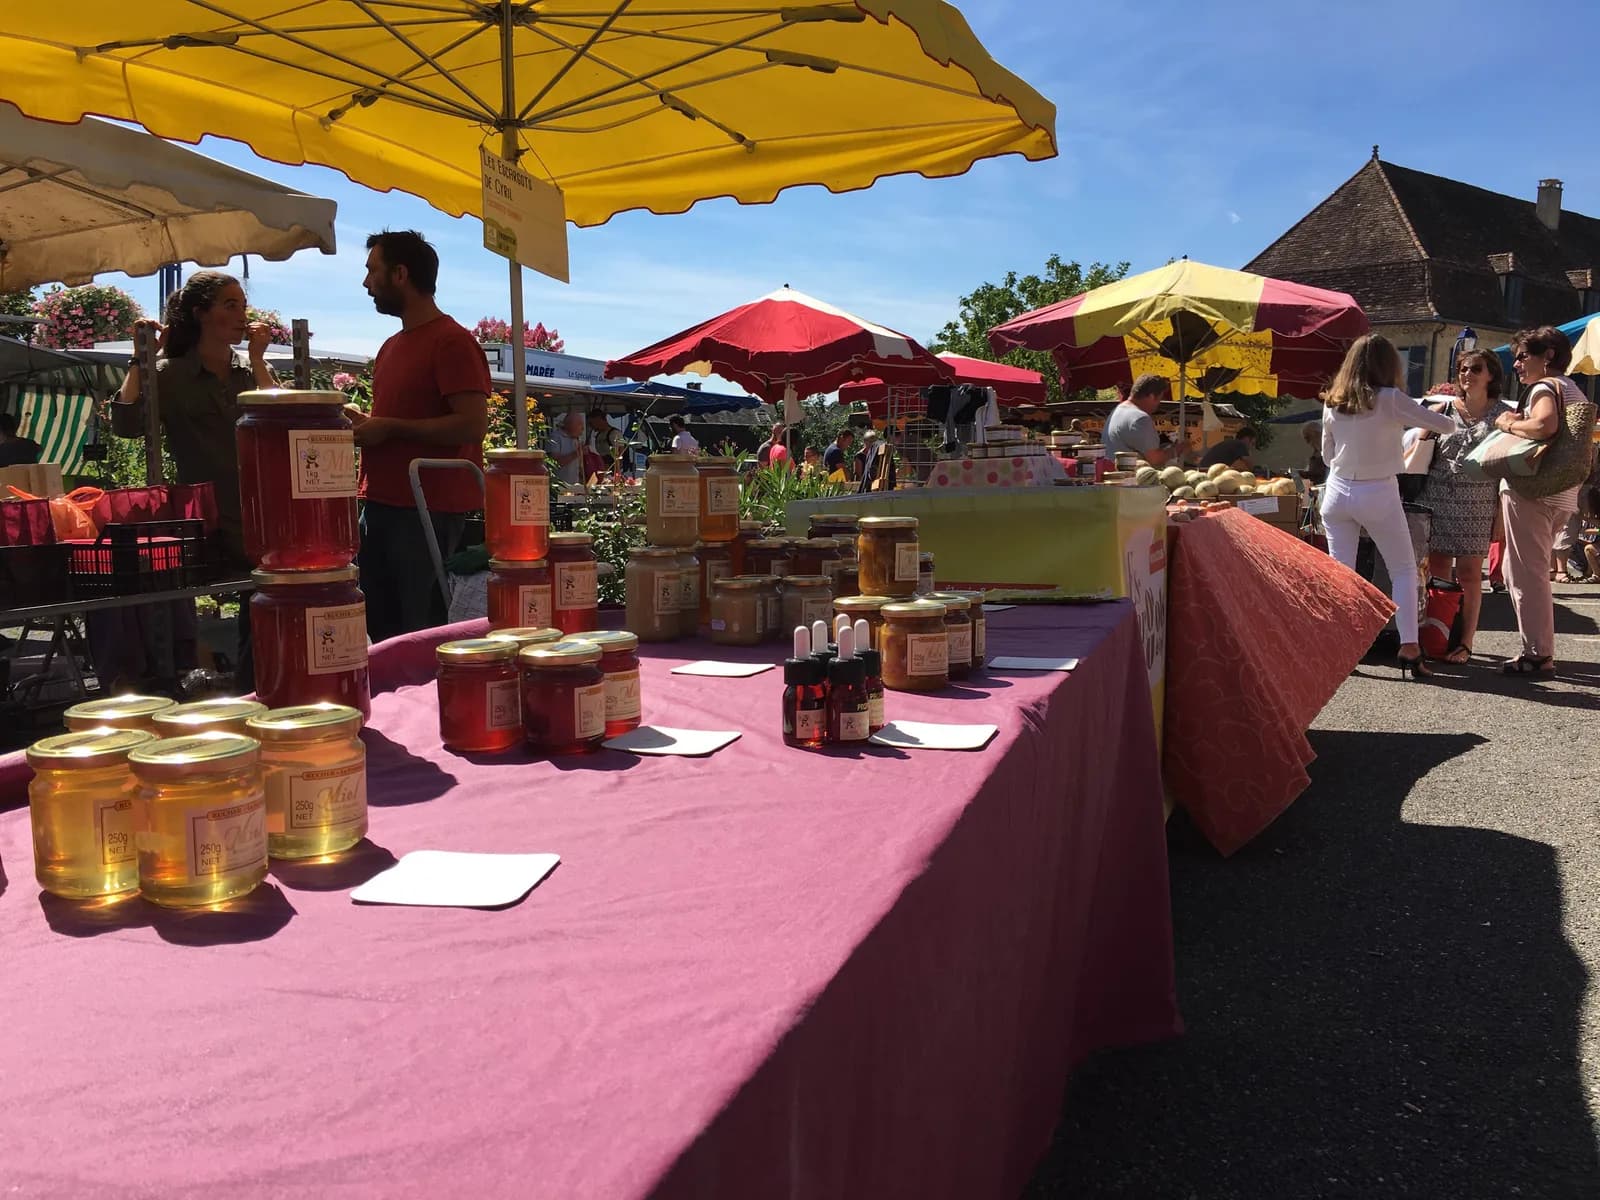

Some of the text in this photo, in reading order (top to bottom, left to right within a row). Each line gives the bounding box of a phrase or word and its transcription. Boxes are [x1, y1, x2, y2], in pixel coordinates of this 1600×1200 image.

[484, 154, 533, 191] LES ESCARGOTS
[484, 174, 513, 201] DE CYRIL
[568, 370, 575, 378] Le
[317, 776, 361, 811] Miel
[295, 800, 314, 812] 250g
[295, 813, 313, 821] NET
[108, 832, 128, 845] 250g
[108, 846, 127, 855] NET
[200, 842, 221, 856] 250g
[202, 857, 220, 866] NET
